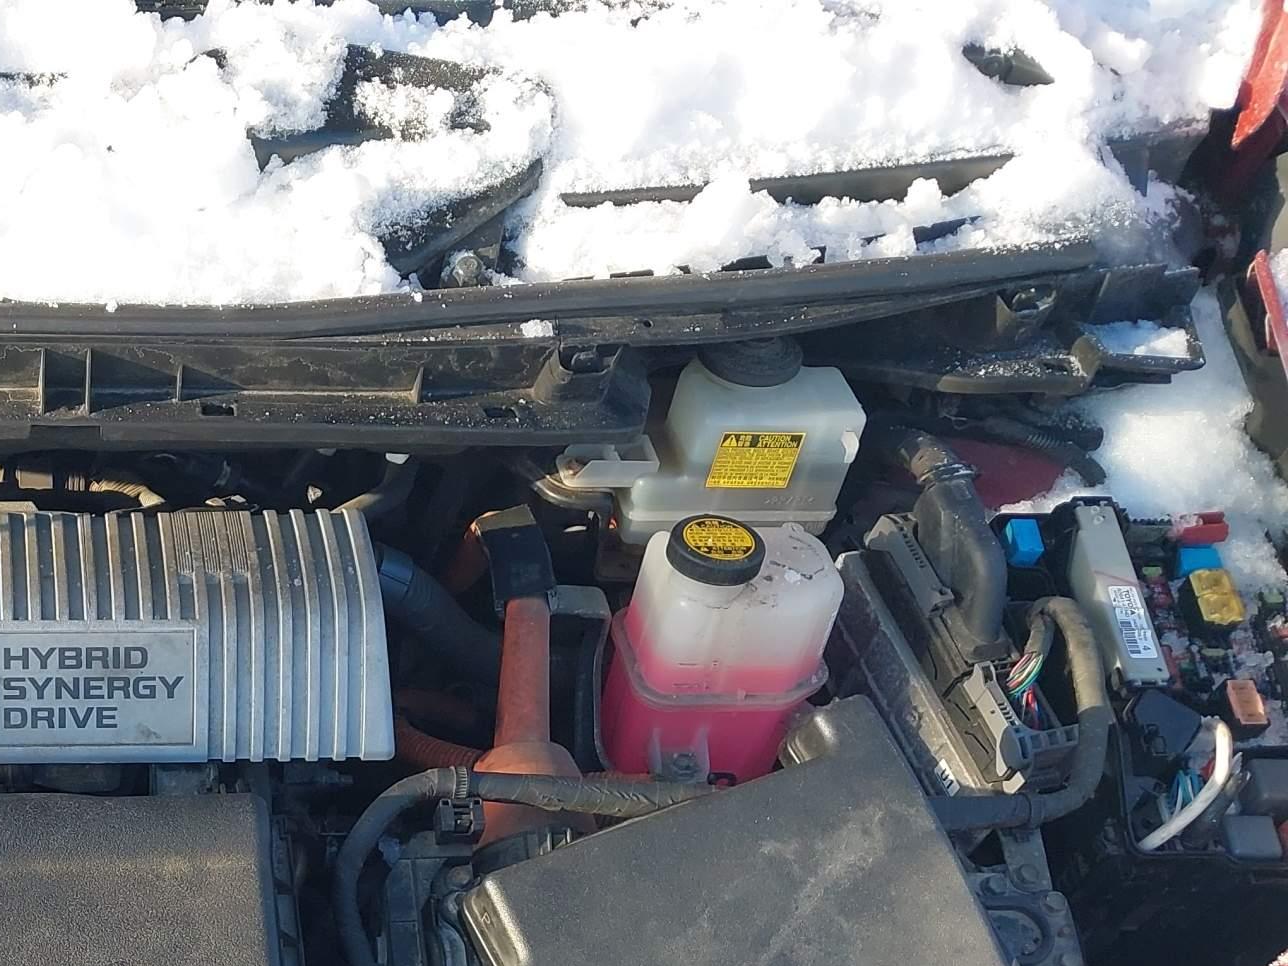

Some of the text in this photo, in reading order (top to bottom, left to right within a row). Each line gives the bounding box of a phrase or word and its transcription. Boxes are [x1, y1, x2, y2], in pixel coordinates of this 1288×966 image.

[3, 646, 148, 670] HYBRID
[3, 676, 185, 700] SYNERGY
[3, 706, 118, 729] DRIVE
